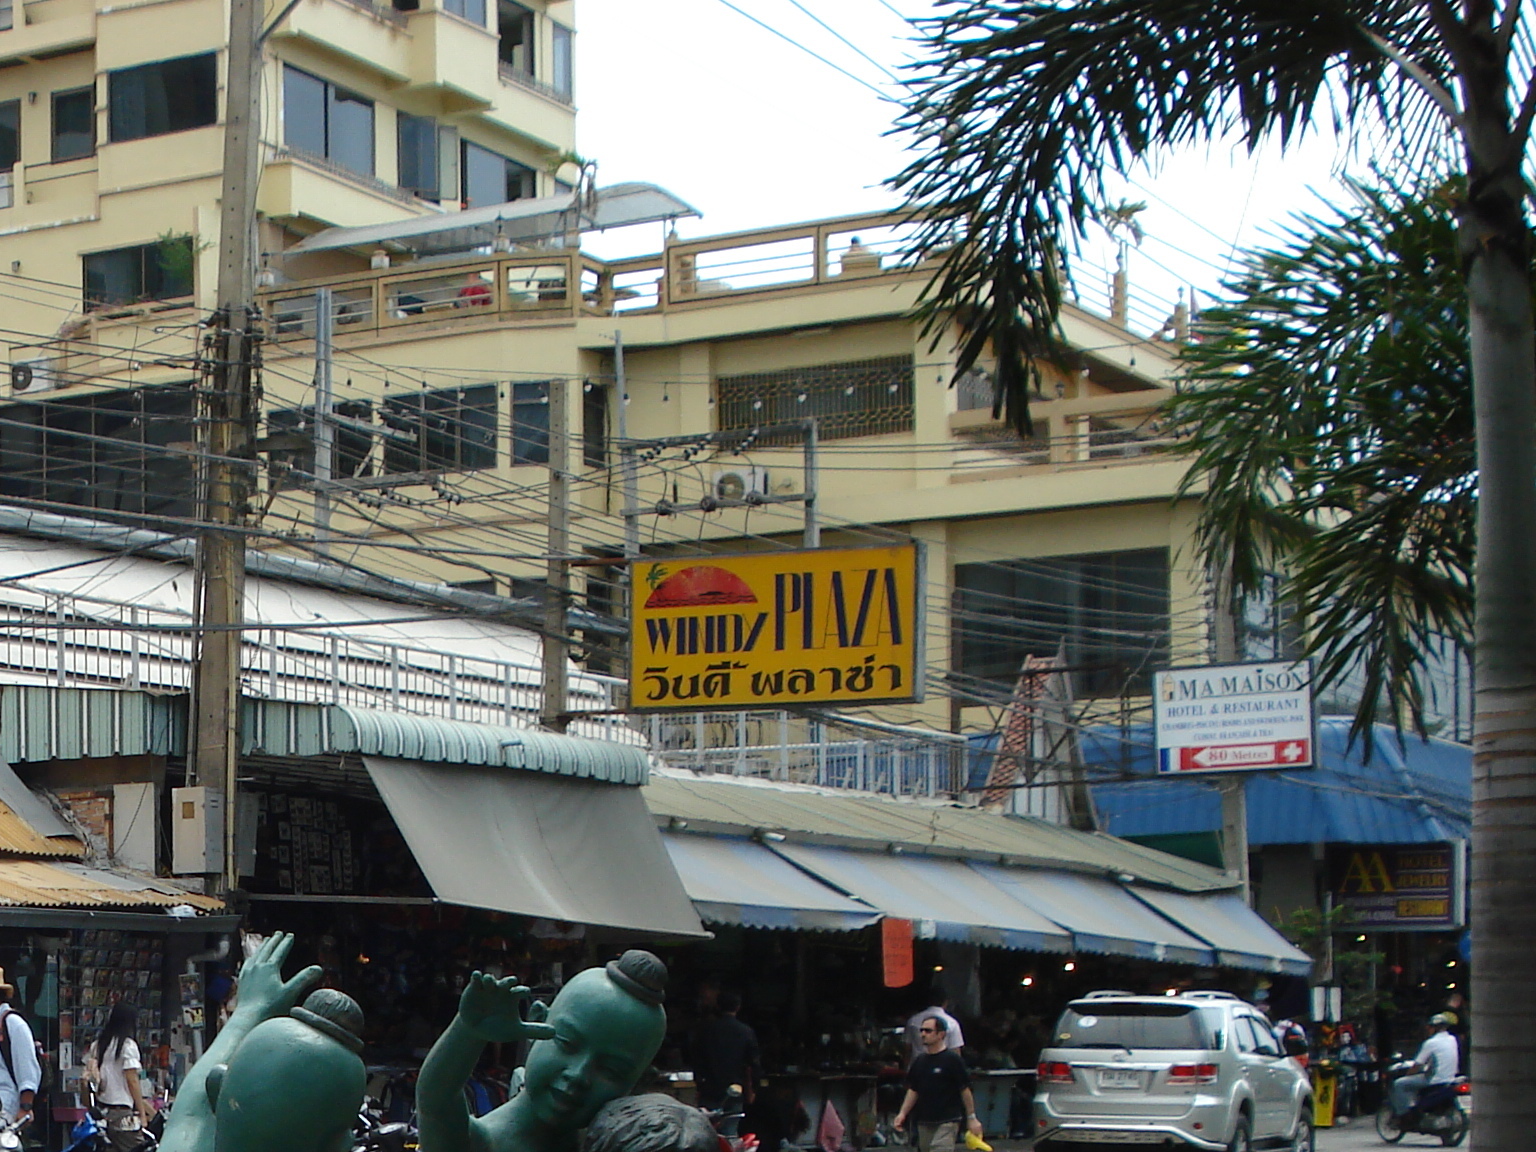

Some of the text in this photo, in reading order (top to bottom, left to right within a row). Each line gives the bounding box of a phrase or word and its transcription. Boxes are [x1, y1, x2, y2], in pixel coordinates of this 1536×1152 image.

[645, 568, 903, 655] WINDY PLAZA
[1179, 671, 1305, 701] MA MAISON
[1167, 698, 1301, 718] HOTEL & RESTAURANT
[1208, 748, 1269, 762] 80 Metres
[1338, 851, 1397, 894] AA
